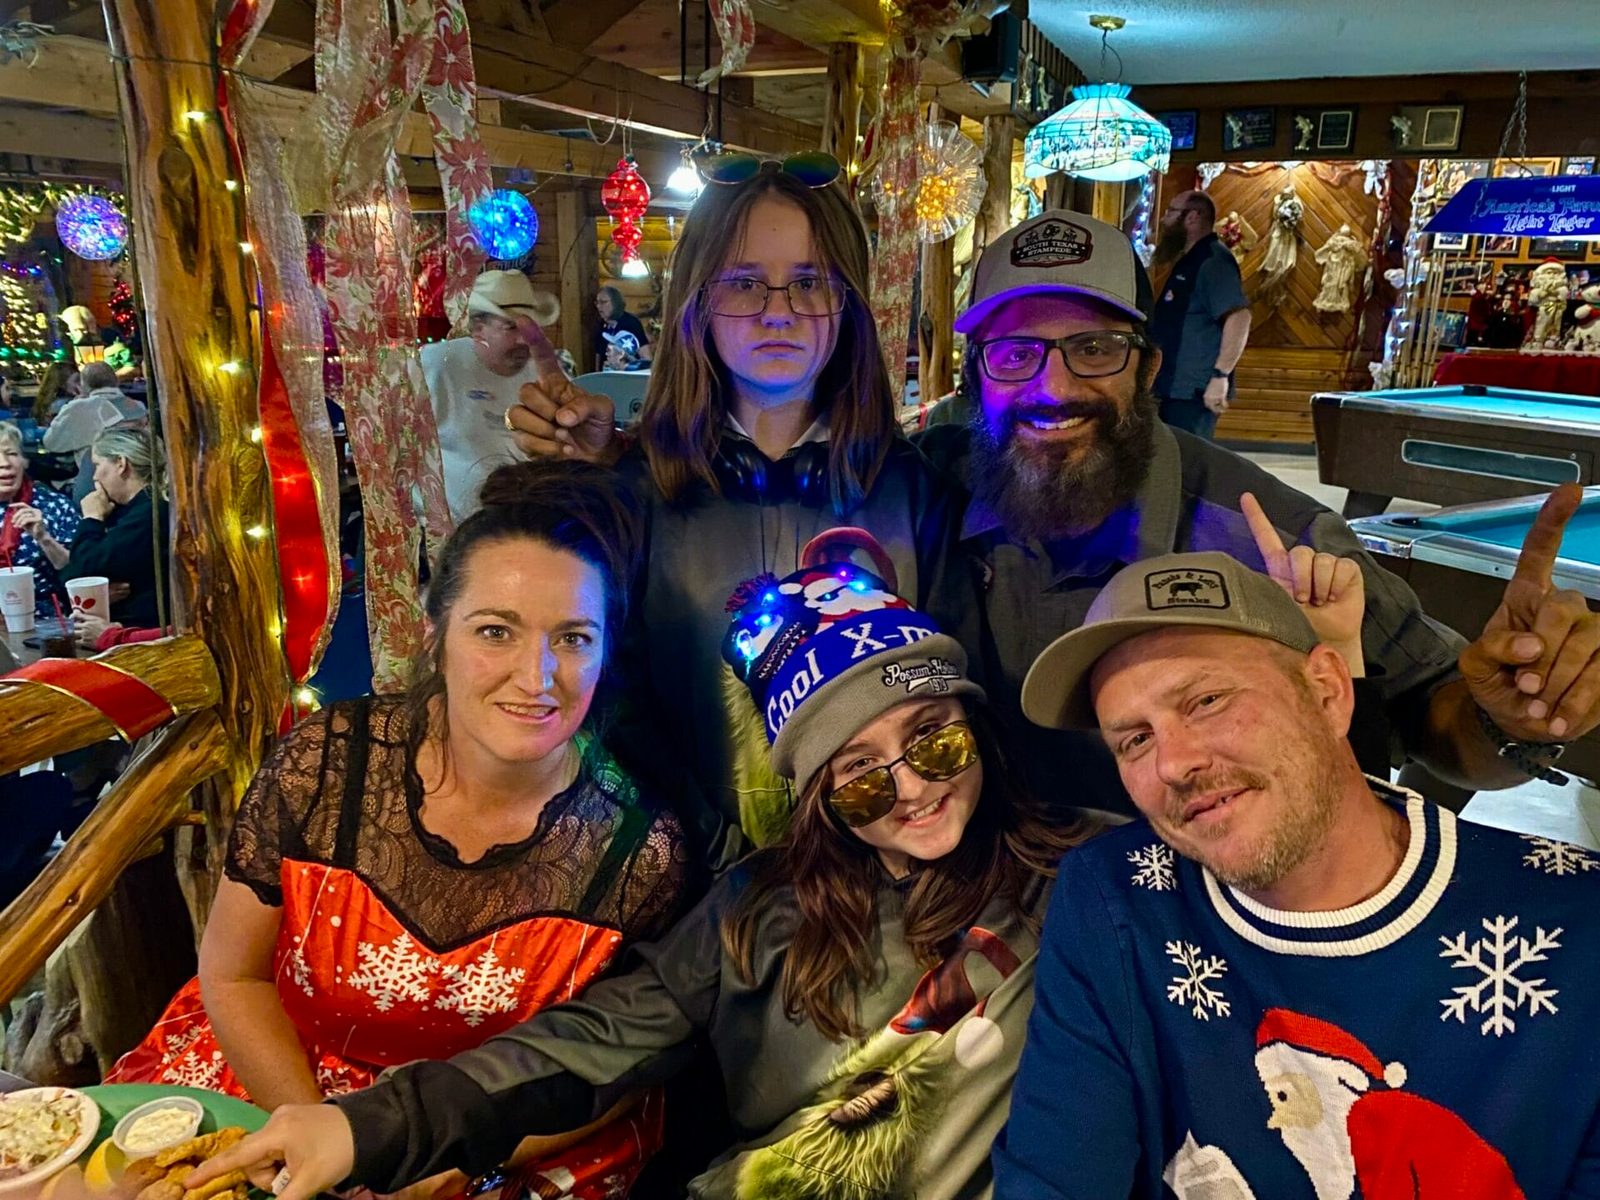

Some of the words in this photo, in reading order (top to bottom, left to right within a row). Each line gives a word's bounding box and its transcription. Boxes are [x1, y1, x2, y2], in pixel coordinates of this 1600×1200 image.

[1552, 185, 1577, 193] LIGHT
[1503, 213, 1545, 233] Light
[1548, 212, 1595, 234] Lager
[1023, 242, 1049, 252] SOUTH
[1051, 241, 1078, 249] TEXAS
[1027, 247, 1072, 256] STAMPEDE
[767, 648, 825, 735] Cool
[840, 622, 939, 659] X-m
[885, 663, 931, 686] Possum
